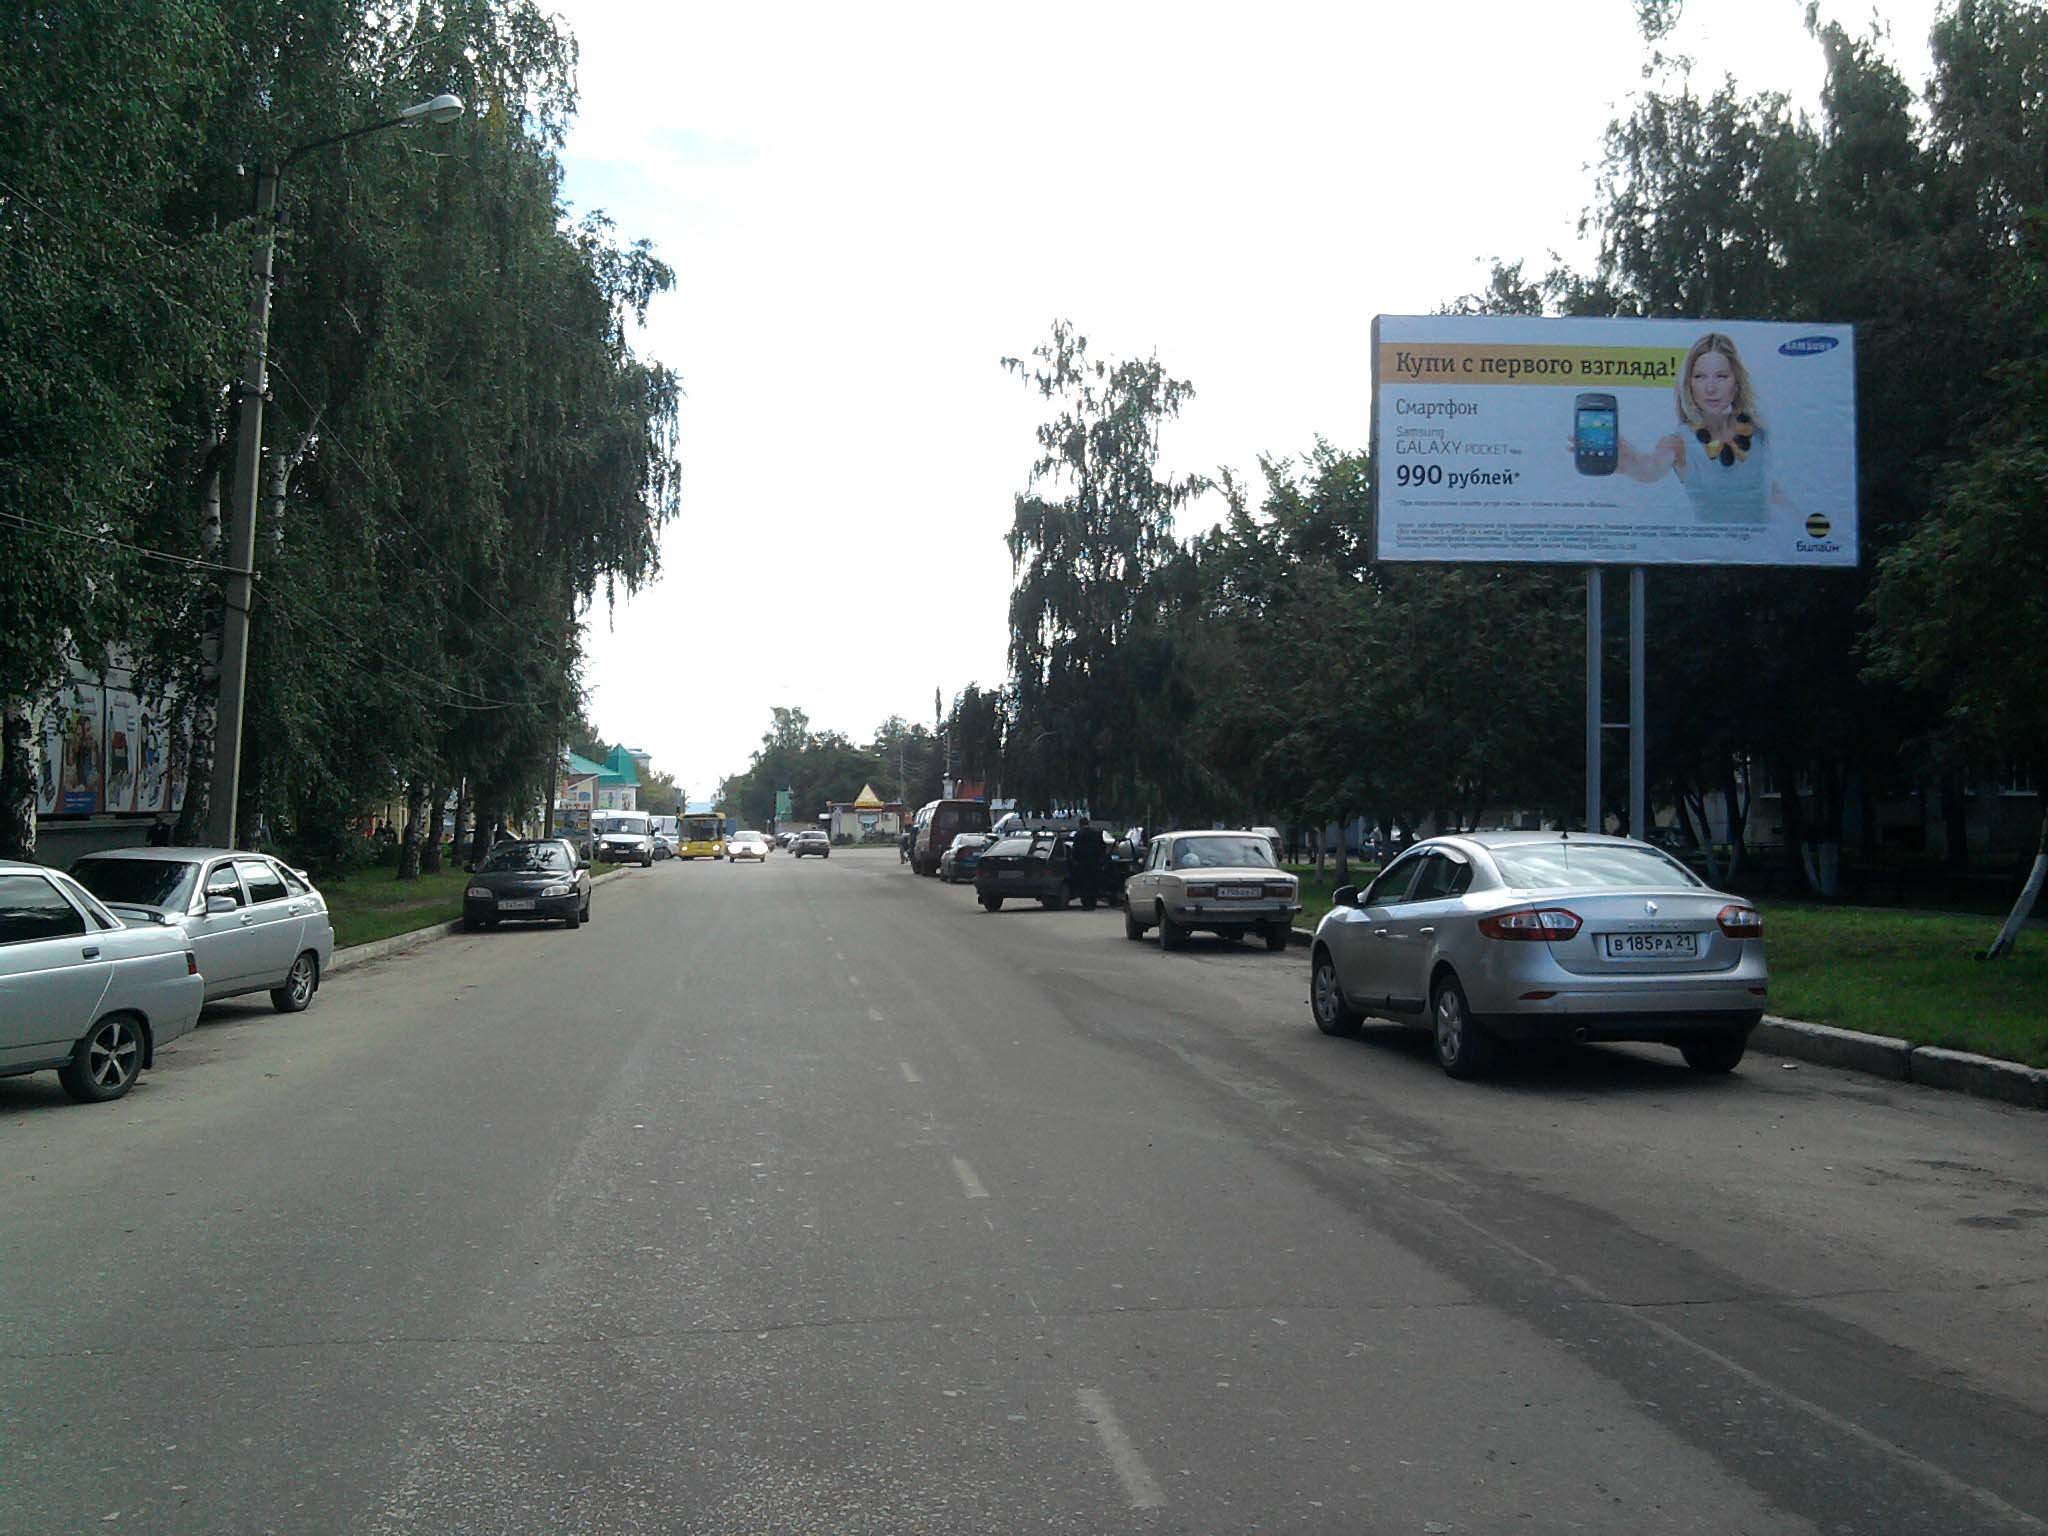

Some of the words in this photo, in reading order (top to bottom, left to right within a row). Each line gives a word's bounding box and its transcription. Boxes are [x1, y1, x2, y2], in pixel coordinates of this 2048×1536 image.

[1396, 352, 1455, 378] Купи
[1462, 357, 1473, 373] с
[1480, 357, 1573, 378] первого
[1580, 356, 1677, 380] взгляда!
[1395, 398, 1479, 419] Смартфон
[1396, 426, 1445, 440] Samsung
[1396, 440, 1461, 455] GALAXY
[1465, 443, 1509, 455] POCKET
[1396, 464, 1442, 487] 990
